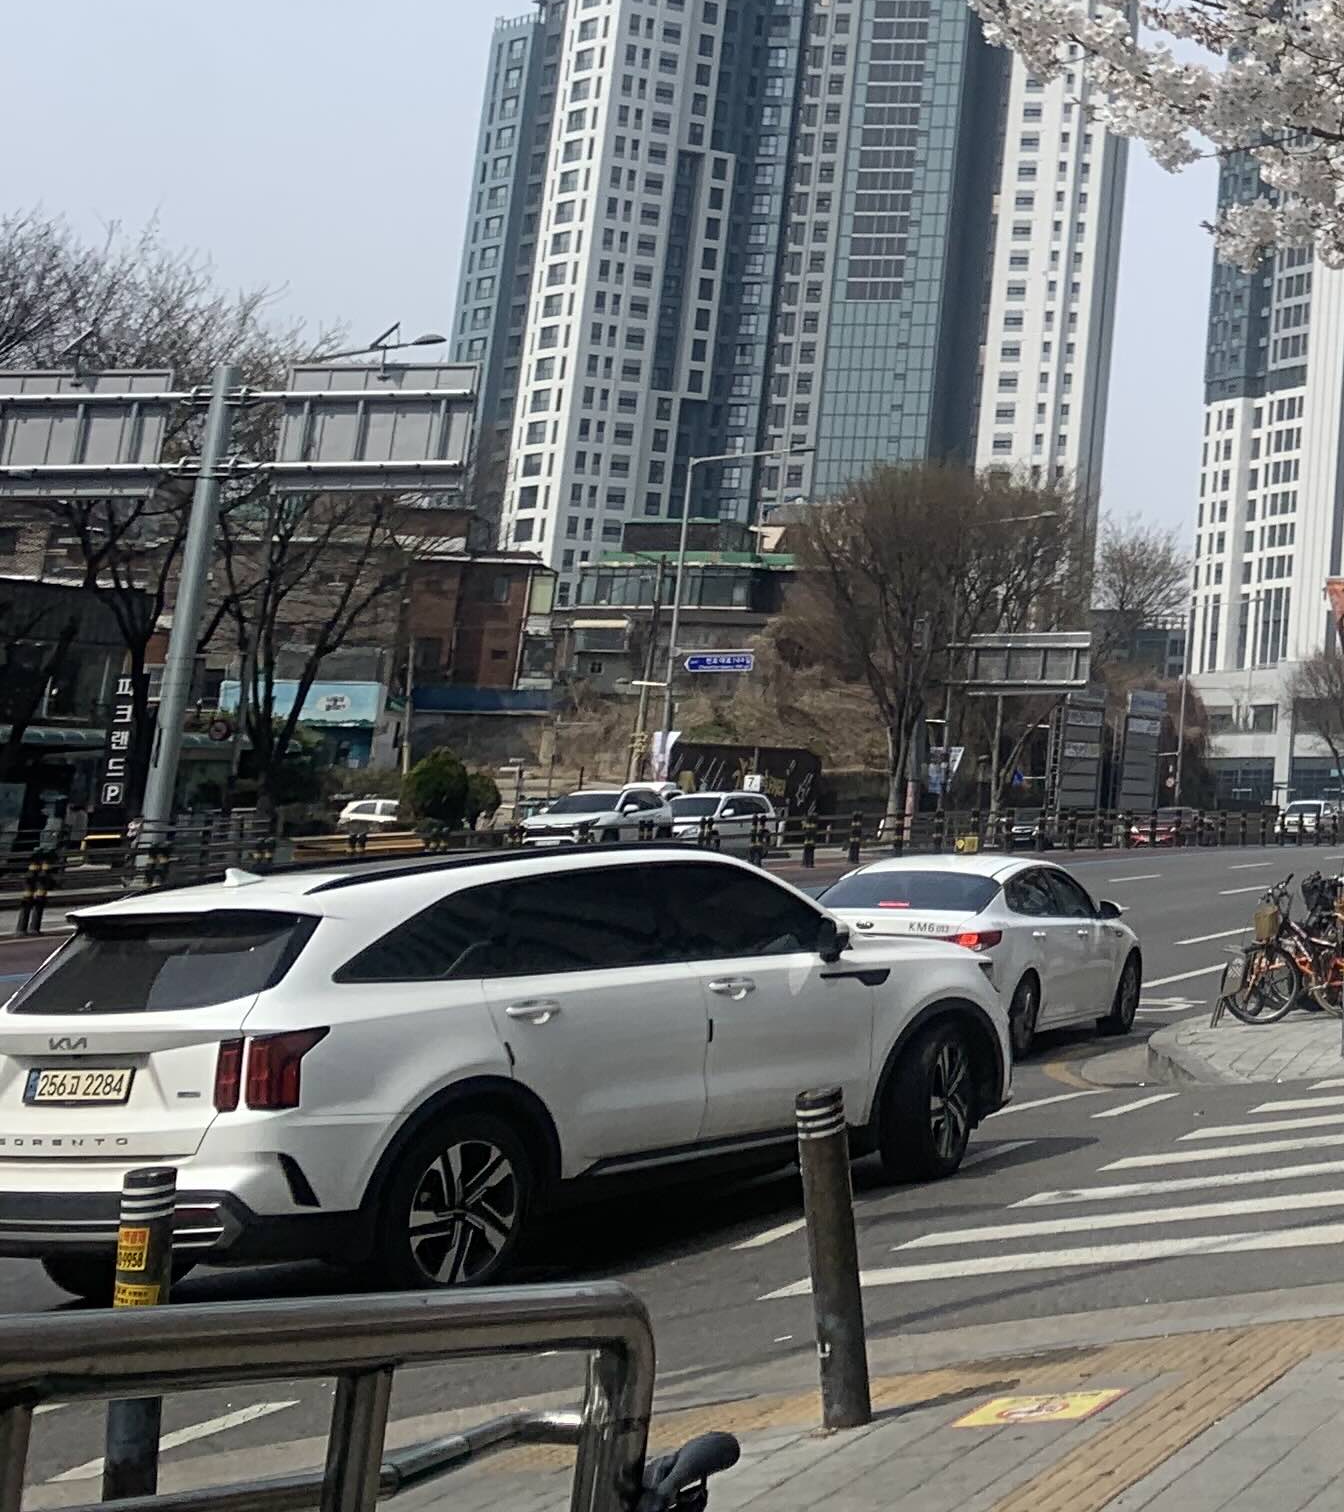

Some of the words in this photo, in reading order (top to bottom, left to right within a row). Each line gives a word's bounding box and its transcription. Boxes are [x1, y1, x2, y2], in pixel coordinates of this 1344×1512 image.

[105, 678, 134, 777] 파크랜드
[49, 1037, 88, 1051] KIA
[82, 1073, 125, 1097] 2284
